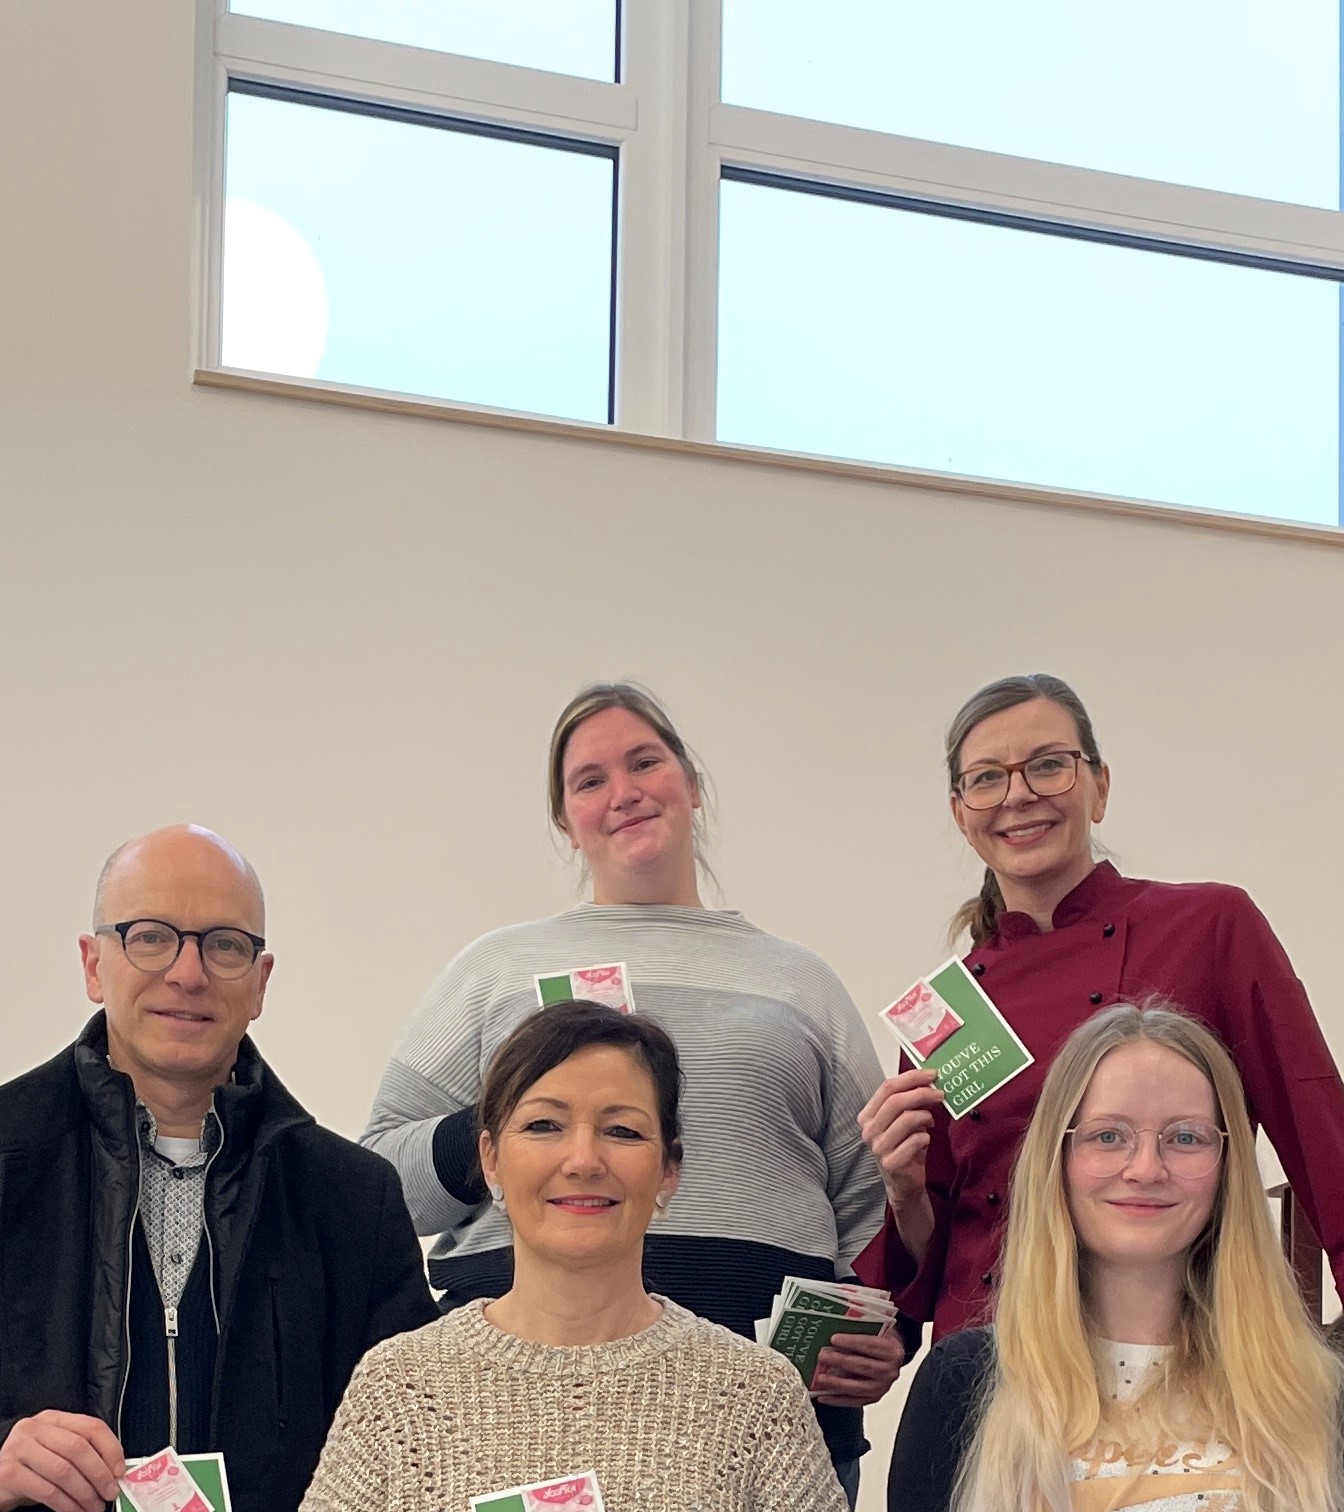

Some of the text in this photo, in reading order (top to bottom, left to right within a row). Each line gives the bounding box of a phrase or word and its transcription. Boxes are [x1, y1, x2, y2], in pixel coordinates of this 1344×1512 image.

[944, 1045, 1001, 1093] GOT THIS
[953, 1081, 985, 1106] GIRL
